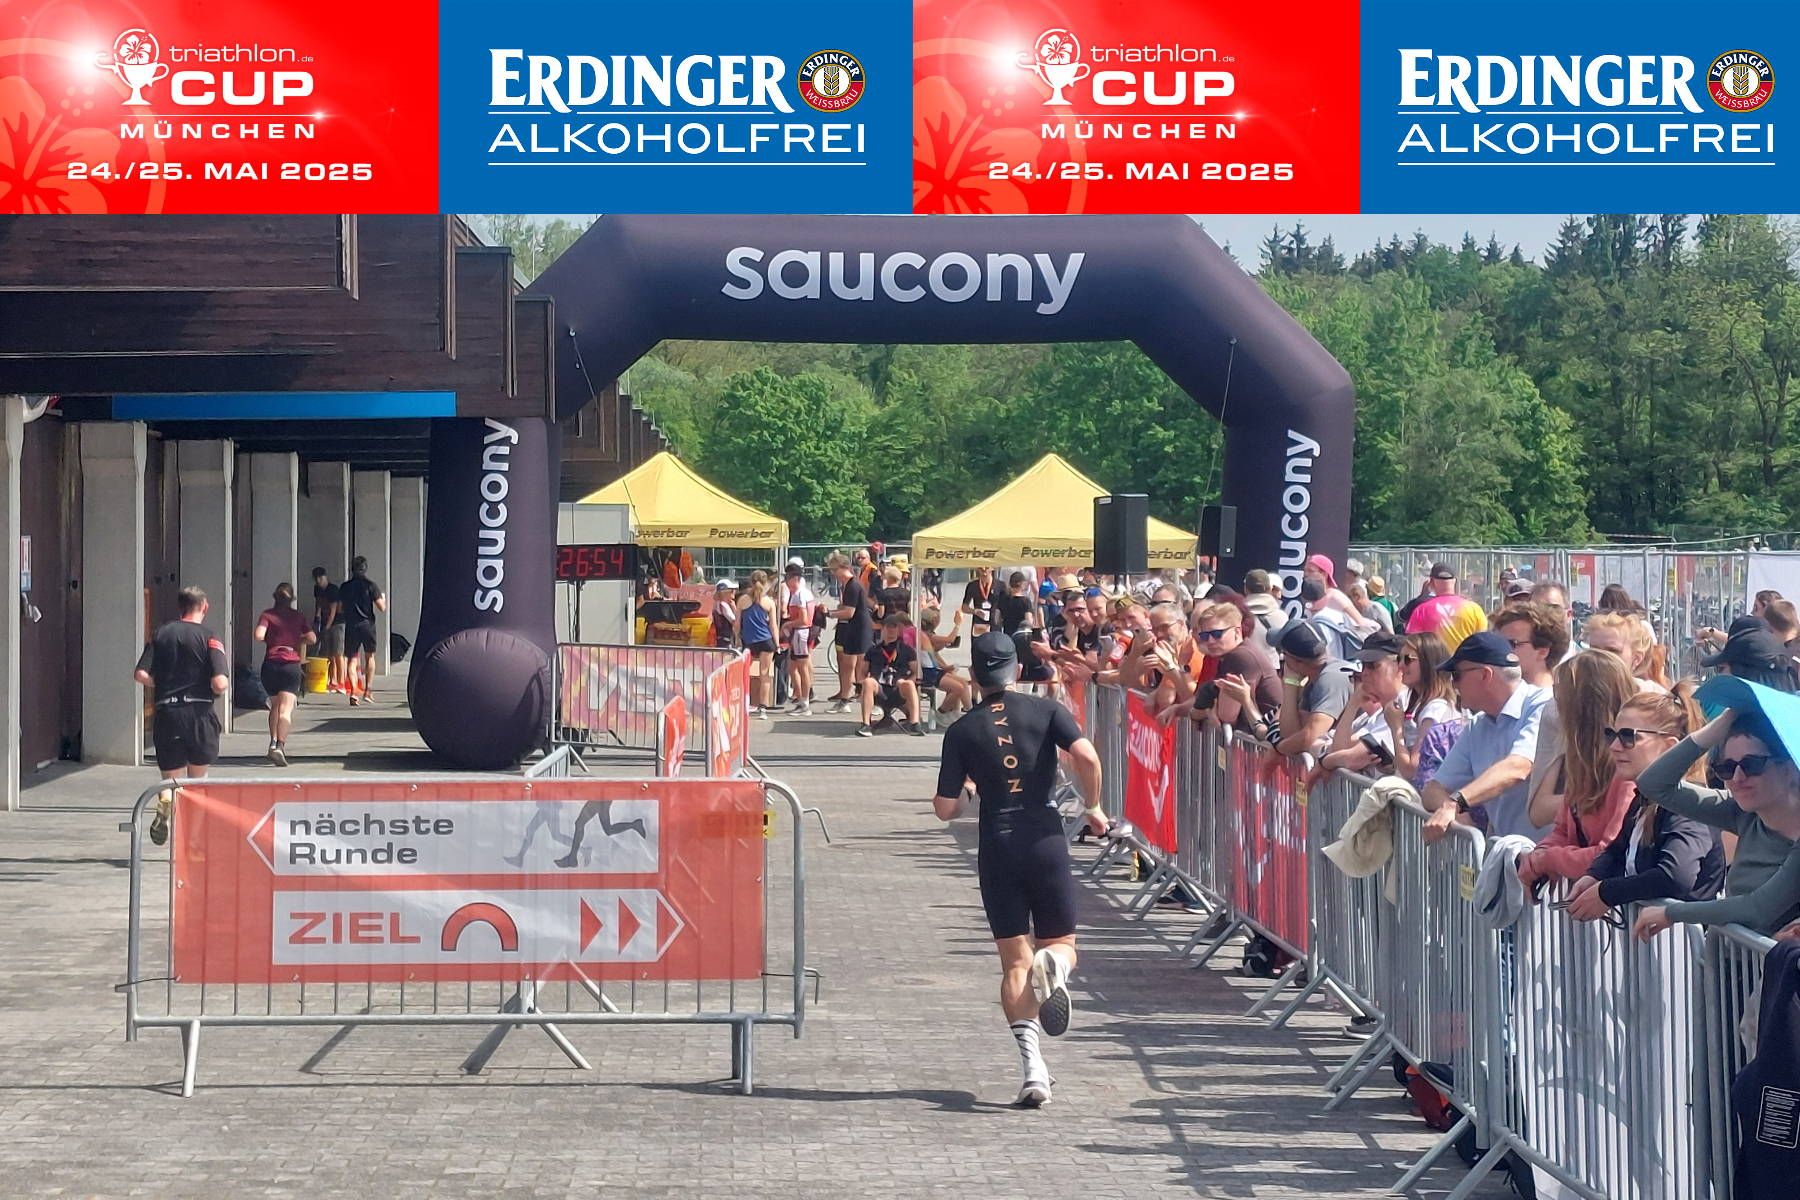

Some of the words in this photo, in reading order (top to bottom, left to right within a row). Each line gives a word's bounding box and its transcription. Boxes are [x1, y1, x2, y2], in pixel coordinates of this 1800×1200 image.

[721, 246, 1086, 315] saucony
[474, 417, 519, 613] saucony
[708, 528, 775, 540] Powerbar
[924, 548, 999, 560] Powerbar
[990, 702, 1024, 793] RYZON
[289, 813, 454, 836] nächste
[289, 841, 418, 865] Runde
[288, 912, 421, 945] ZIEL
